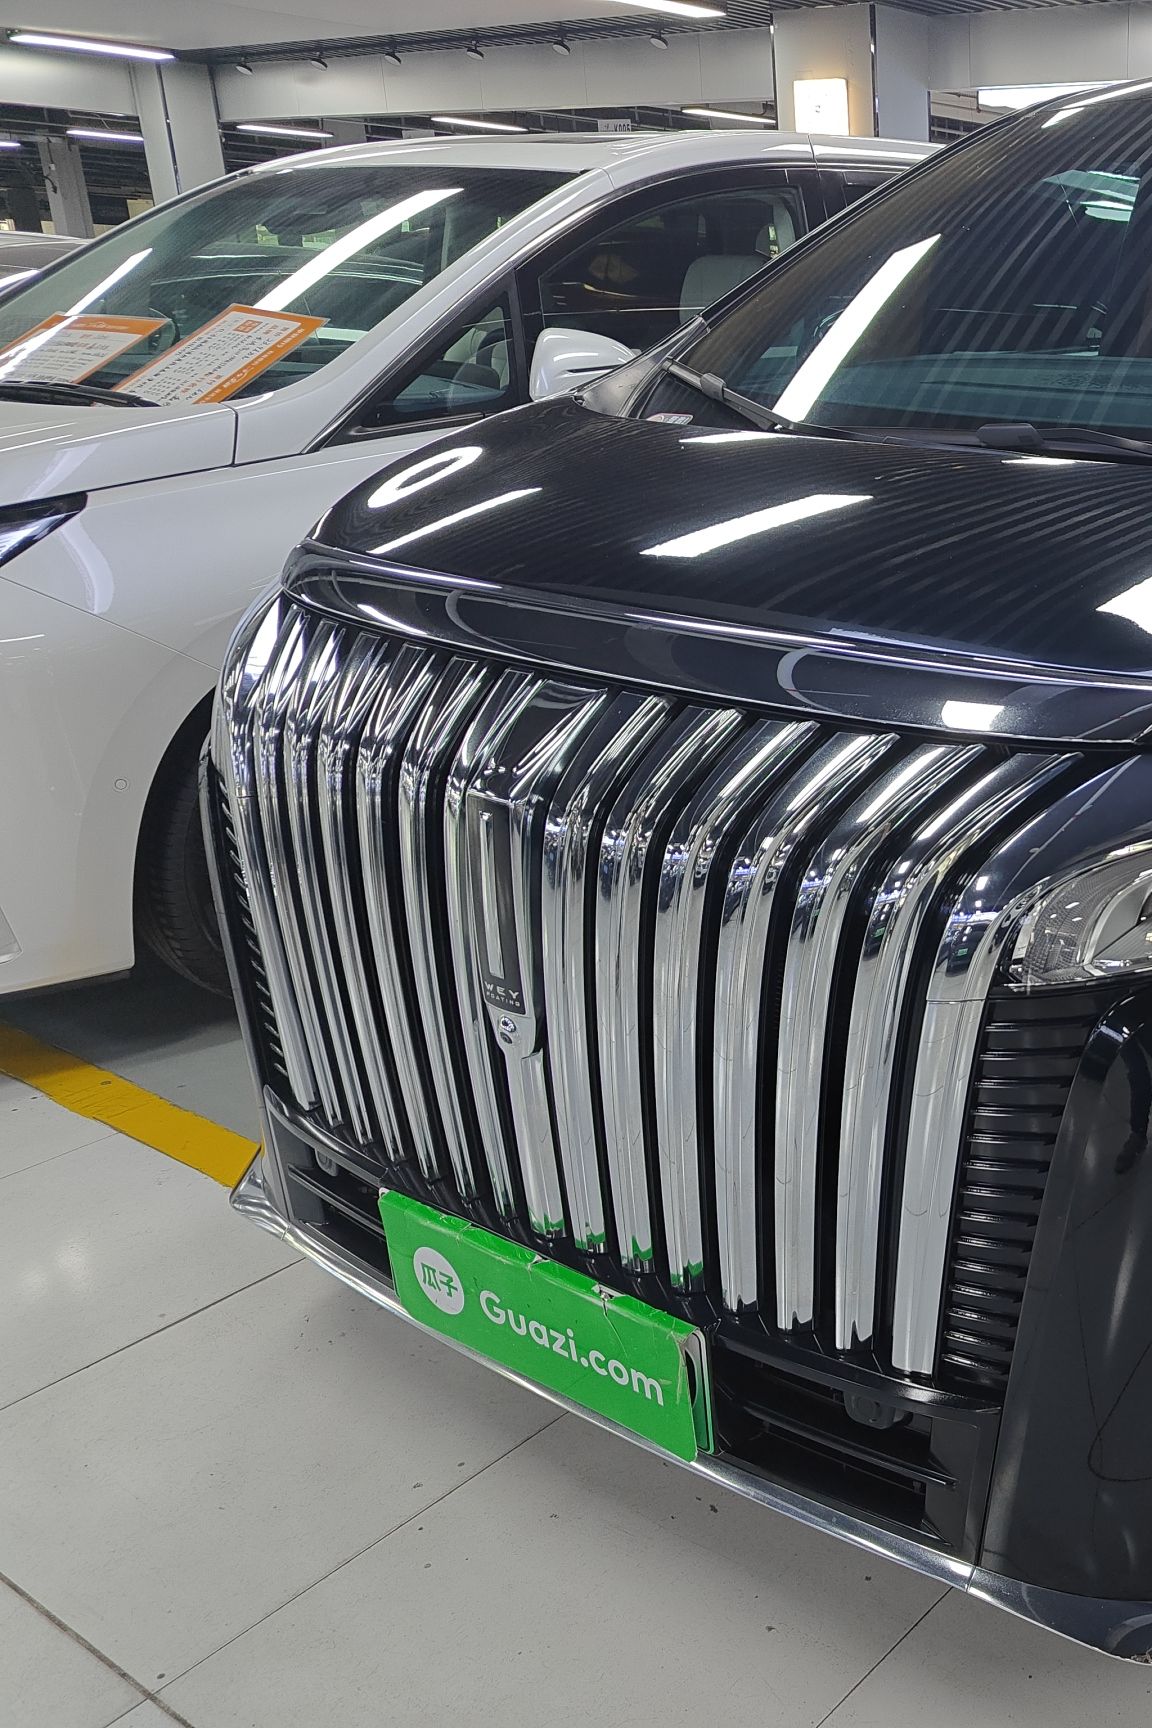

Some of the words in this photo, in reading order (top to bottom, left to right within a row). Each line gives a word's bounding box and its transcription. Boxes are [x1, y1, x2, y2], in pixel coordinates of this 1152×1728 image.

[484, 980, 519, 999] WEY
[420, 1262, 458, 1298] 瓜子
[479, 1289, 664, 1407] Guazi.com
